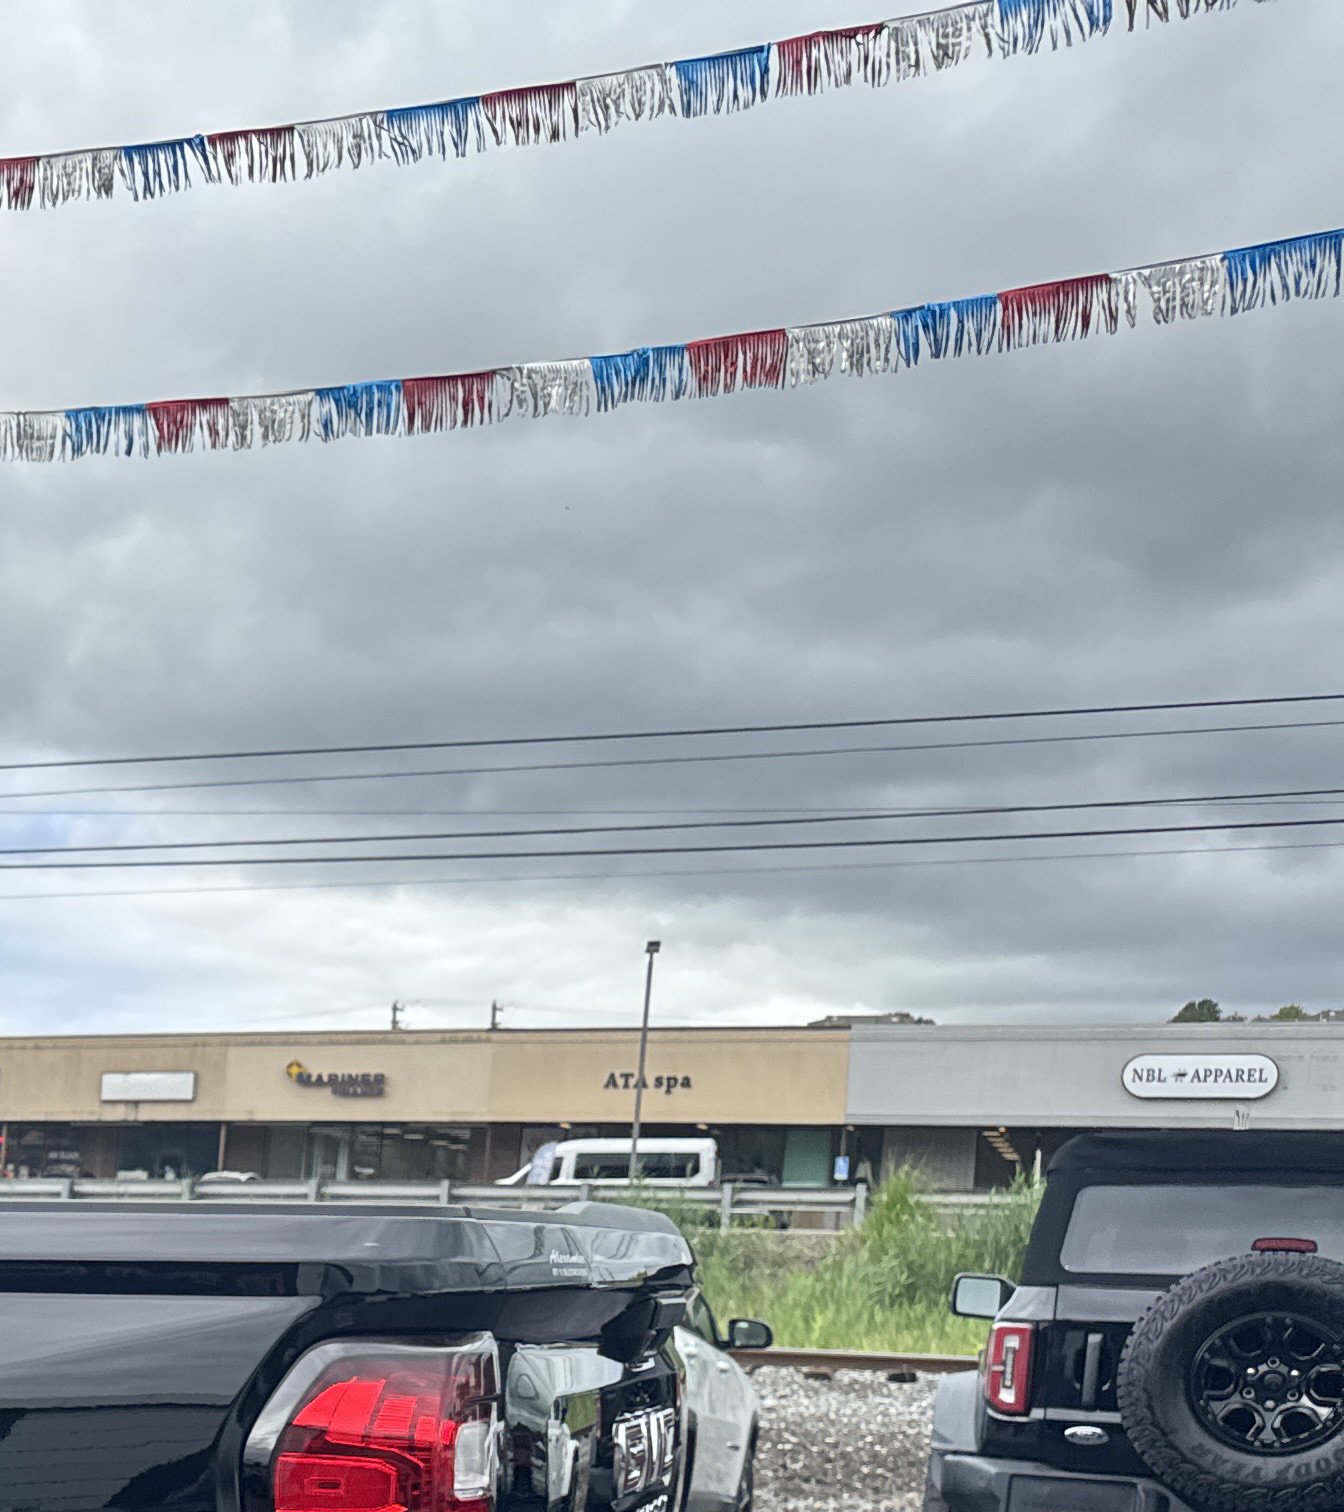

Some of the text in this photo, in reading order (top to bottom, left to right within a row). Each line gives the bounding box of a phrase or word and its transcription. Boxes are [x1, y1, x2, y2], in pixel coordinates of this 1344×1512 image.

[654, 1074, 691, 1095] spa
[1131, 1067, 1269, 1084] NBL APPAREL
